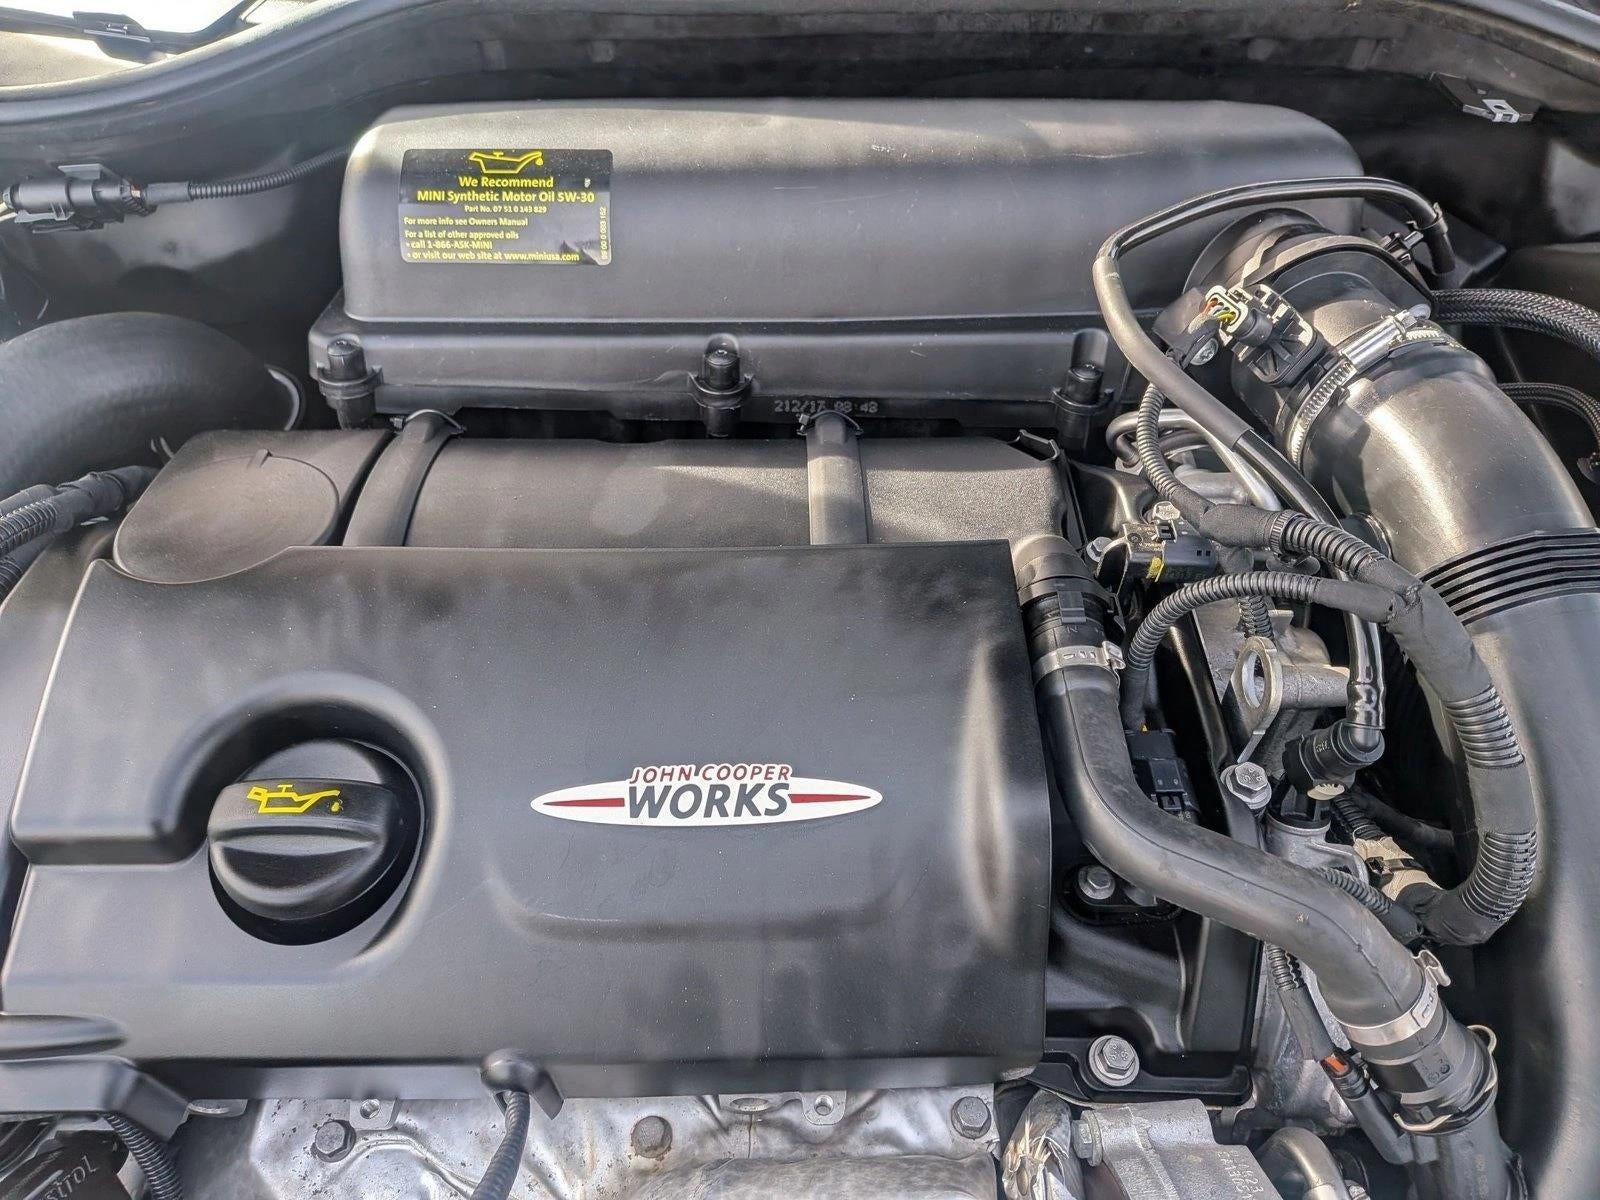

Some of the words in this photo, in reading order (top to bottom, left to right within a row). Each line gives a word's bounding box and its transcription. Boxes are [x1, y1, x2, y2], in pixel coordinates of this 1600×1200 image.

[458, 176, 479, 188] We
[481, 176, 554, 188] Recommend
[417, 190, 445, 201] MINI
[447, 190, 500, 205] Synthetic
[502, 191, 537, 202] Motor
[538, 191, 555, 202] Oil
[556, 191, 595, 203] 5W-30
[464, 205, 479, 213] Part
[480, 205, 492, 213] No.
[403, 217, 416, 225] For
[439, 217, 454, 225] info
[455, 218, 468, 226] see
[468, 217, 498, 226] Owners
[499, 217, 529, 226] Manual
[404, 230, 417, 238] For
[424, 230, 437, 238] list
[437, 230, 446, 238] of
[447, 230, 468, 239] other
[469, 231, 505, 241] approved
[505, 230, 519, 239] oils
[410, 240, 426, 249] call
[427, 240, 493, 250] 1-866-ASK-MINI
[412, 252, 422, 260] or
[422, 251, 441, 260] visit
[442, 252, 456, 260] our
[457, 251, 476, 260] web
[477, 251, 493, 260] site
[493, 251, 503, 260] at
[503, 251, 580, 262] www.miniusa.com
[628, 765, 692, 785] JOHN
[701, 763, 792, 782] COOPER
[627, 782, 791, 820] WORKS
